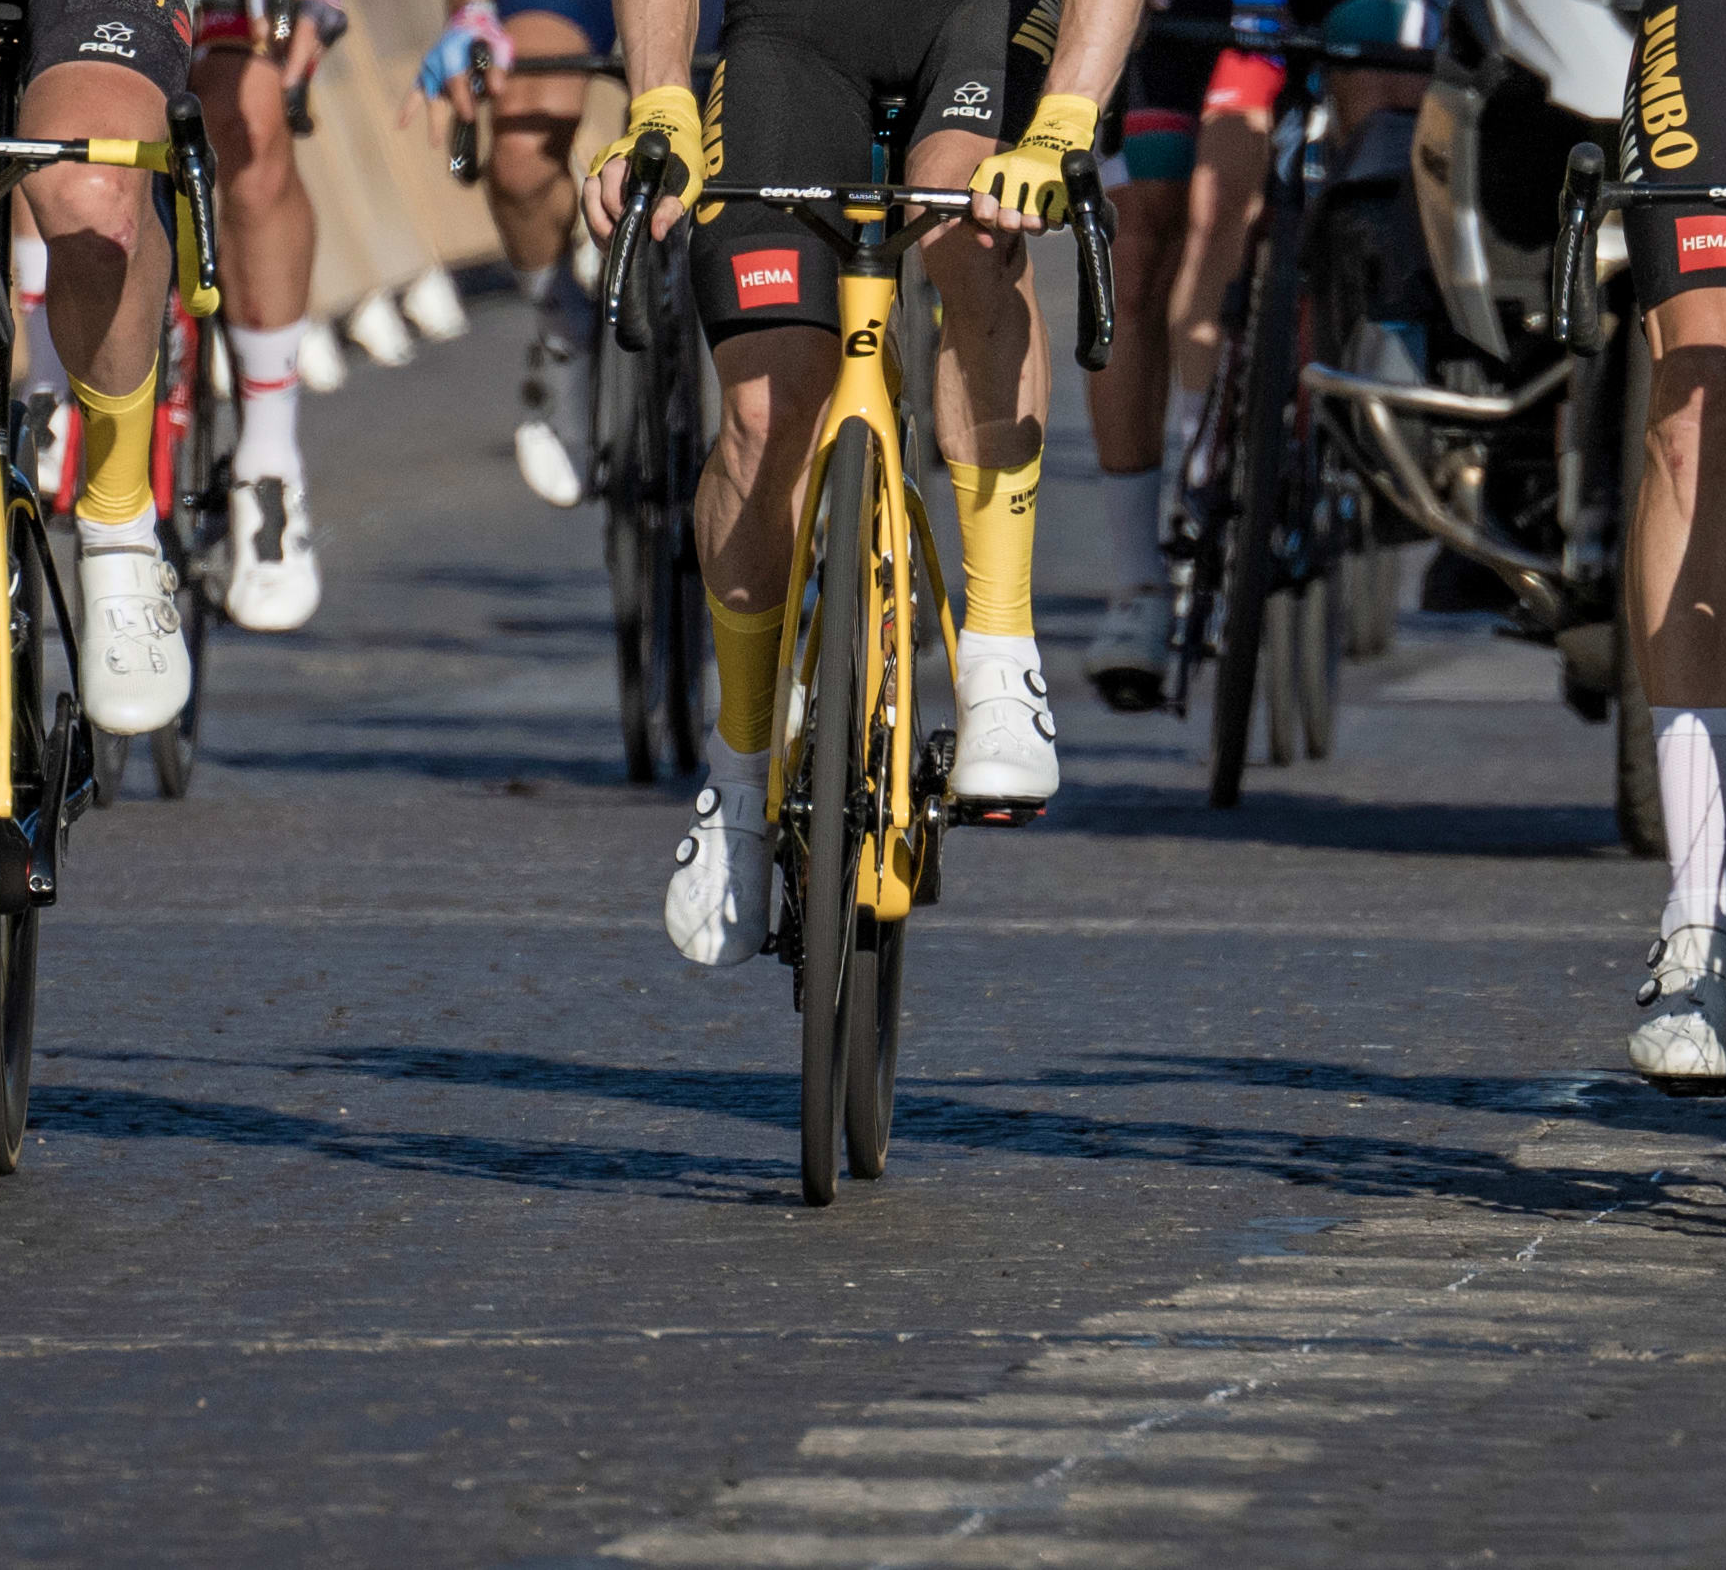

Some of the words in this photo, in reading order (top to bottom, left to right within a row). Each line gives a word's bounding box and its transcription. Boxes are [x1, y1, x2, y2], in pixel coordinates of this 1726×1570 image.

[78, 41, 136, 59] AGU
[1640, 5, 1700, 170] JUMBO
[942, 105, 993, 121] AGU
[759, 185, 832, 199] cervélo
[740, 267, 794, 288] HEMA
[845, 319, 882, 359] é
